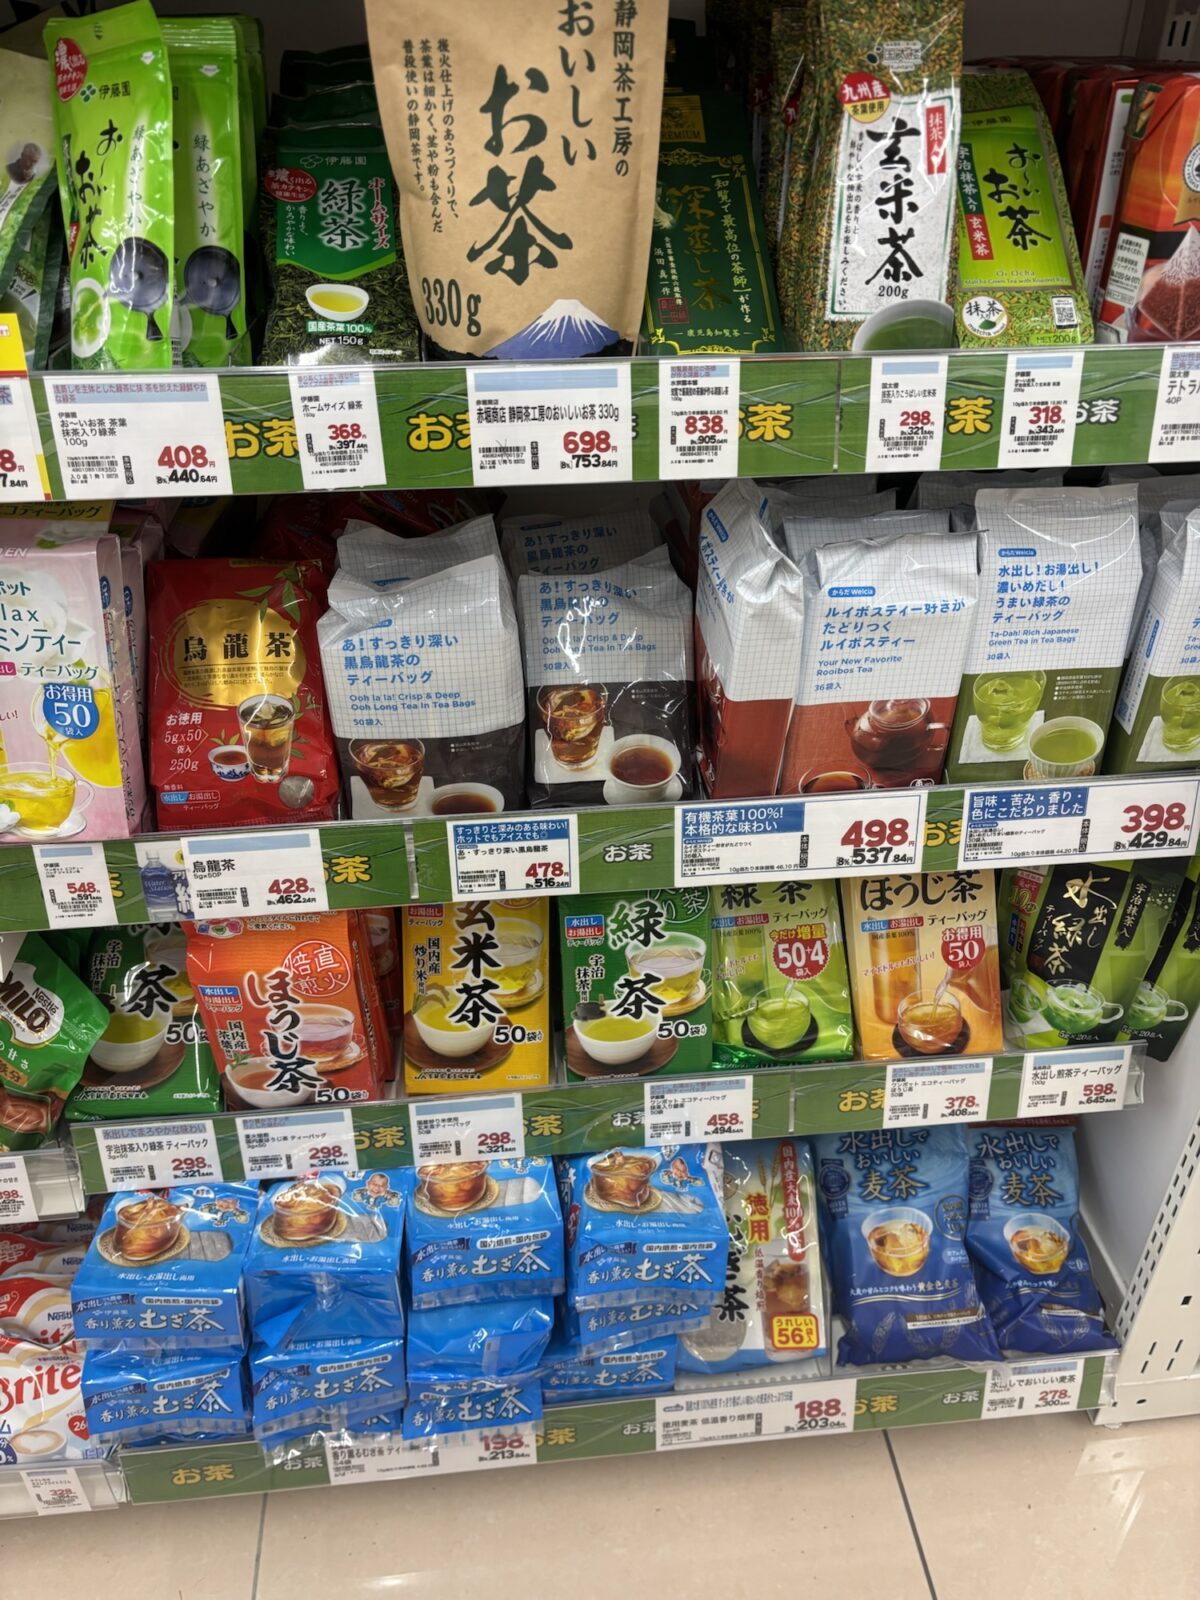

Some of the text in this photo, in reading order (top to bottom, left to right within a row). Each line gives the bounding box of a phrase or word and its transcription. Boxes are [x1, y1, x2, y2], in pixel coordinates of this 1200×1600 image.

[99, 81, 131, 99] 伊藤園
[558, 0, 597, 167] おいしい
[611, 0, 639, 178] 静岡茶工房の
[842, 79, 888, 102] 九州産
[325, 156, 367, 166] 伊藤園
[467, 64, 573, 287] お茶
[193, 133, 217, 238] 緑あざやか
[866, 116, 925, 286] 玄米茶
[982, 168, 1052, 251] お茶
[319, 177, 369, 251] 緑茶
[368, 177, 391, 251] ホームサイズ
[969, 216, 990, 257] 玄米茶
[878, 284, 909, 300] 200g
[421, 277, 482, 337] 330g
[965, 301, 1003, 316] 抹茶
[307, 321, 373, 334] 国産茶葉100%
[318, 335, 364, 346] NET 150g
[1053, 334, 1078, 345] 200g
[302, 400, 364, 413] ホームサイズ 緑茶
[1165, 396, 1182, 405] 40P
[476, 403, 620, 424] 赤堀商店 静岡茶工房のおいしいお茶 330g
[60, 418, 128, 428] お〜いお茶 茶葉
[61, 427, 117, 437] 抹茶入り緑茶
[63, 438, 88, 447] 100g
[223, 417, 299, 459] お茶
[824, 599, 967, 619] ルイボスティー好きが
[995, 595, 1071, 610] うまい緑茶の
[991, 610, 1065, 624] ティーバッグ
[822, 620, 893, 635] たどりつく
[989, 627, 1080, 639] Ta-Dah! Rich Japanese
[183, 632, 292, 662] 烏龍茶
[819, 635, 916, 652] ルイボスティー
[988, 635, 1077, 647] Green Tea in Tea Bags
[343, 653, 421, 671] 黒烏龍茶の
[818, 655, 903, 668] Your New Favorite
[986, 653, 1011, 661] 30袋入
[21, 661, 99, 681] ティーバッグ
[346, 669, 434, 687] ティーバッグ
[816, 666, 874, 677] Rooibos Tea
[44, 683, 94, 703] お得用
[349, 693, 373, 703] Ooh
[373, 693, 382, 702] la
[397, 691, 424, 703] Crisp
[425, 691, 433, 700] &
[434, 690, 461, 702] Deep
[350, 699, 476, 713] Ooh Long Tea In Tea Bags
[54, 702, 93, 729] 50
[166, 712, 203, 727] お徳用
[352, 717, 384, 727] 50袋入
[176, 744, 193, 754] 袋入
[168, 758, 200, 773] 250g
[973, 791, 1083, 808] 旨味・苦み・香り・
[684, 807, 784, 824] 有機茶葉100%!
[971, 803, 1084, 821] 色にこだわりました
[684, 820, 778, 836] 本格的な味わい
[603, 843, 653, 863] お茶
[192, 858, 236, 874] 烏龍茶
[860, 870, 984, 912] ほうじ茶
[409, 906, 443, 917] お湯出し
[772, 907, 829, 923] ティーバッグ
[926, 908, 988, 926] ティーバッグ
[408, 918, 444, 928] ティーバッグ
[570, 916, 598, 927] 水出し
[712, 914, 768, 928] 水出し お湯出し
[862, 918, 924, 931] 水出し お湯出し
[568, 927, 602, 938] お湯出し
[769, 923, 827, 941] 今だけ増量
[941, 926, 983, 942] お得用
[106, 940, 122, 968] 宇治
[428, 937, 441, 975] 国内産
[948, 940, 980, 962] 50
[449, 901, 504, 1028] 玄米茶
[590, 955, 605, 979] 宇治
[609, 901, 667, 1020] 緑茶
[795, 968, 812, 977] 袋入
[121, 963, 180, 1018] 茶
[204, 987, 234, 996] 水出し
[244, 969, 326, 1094] ほうじ茶
[1031, 1064, 1123, 1081] 水出し煎茶ティーバッグ
[842, 1128, 930, 1154] 水出しで
[978, 1131, 1060, 1159] 水出しで
[857, 1149, 920, 1169] おいしい
[999, 1153, 1056, 1171] おいしい
[861, 1166, 930, 1201] 麦茶
[1002, 1173, 1062, 1207] 麦茶
[749, 1192, 771, 1244] 徳用
[421, 1243, 552, 1283] 香り薫る むぎ茶
[587, 1253, 713, 1285] 香り薫る むぎ茶
[117, 1271, 196, 1282] 水出し・お湯出し両用
[76, 1300, 103, 1312] 水出し
[85, 1307, 226, 1333] 香り薫る むぎ茶
[776, 1318, 814, 1328] うれしい
[777, 1327, 804, 1346] 56
[806, 1328, 814, 1344] 袋入
[593, 1362, 665, 1387] むぎ茶
[264, 1366, 394, 1411] 香り薫る むぎ茶
[942, 1390, 980, 1405] お茶
[100, 1379, 234, 1423] 香り薫る むぎ茶
[412, 1386, 533, 1426] 香り薫る むぎ茶
[662, 1413, 755, 1429] 徳用麦茶 低温香り焙煎
[283, 1456, 324, 1470] お茶
[171, 1463, 236, 1486] お茶
